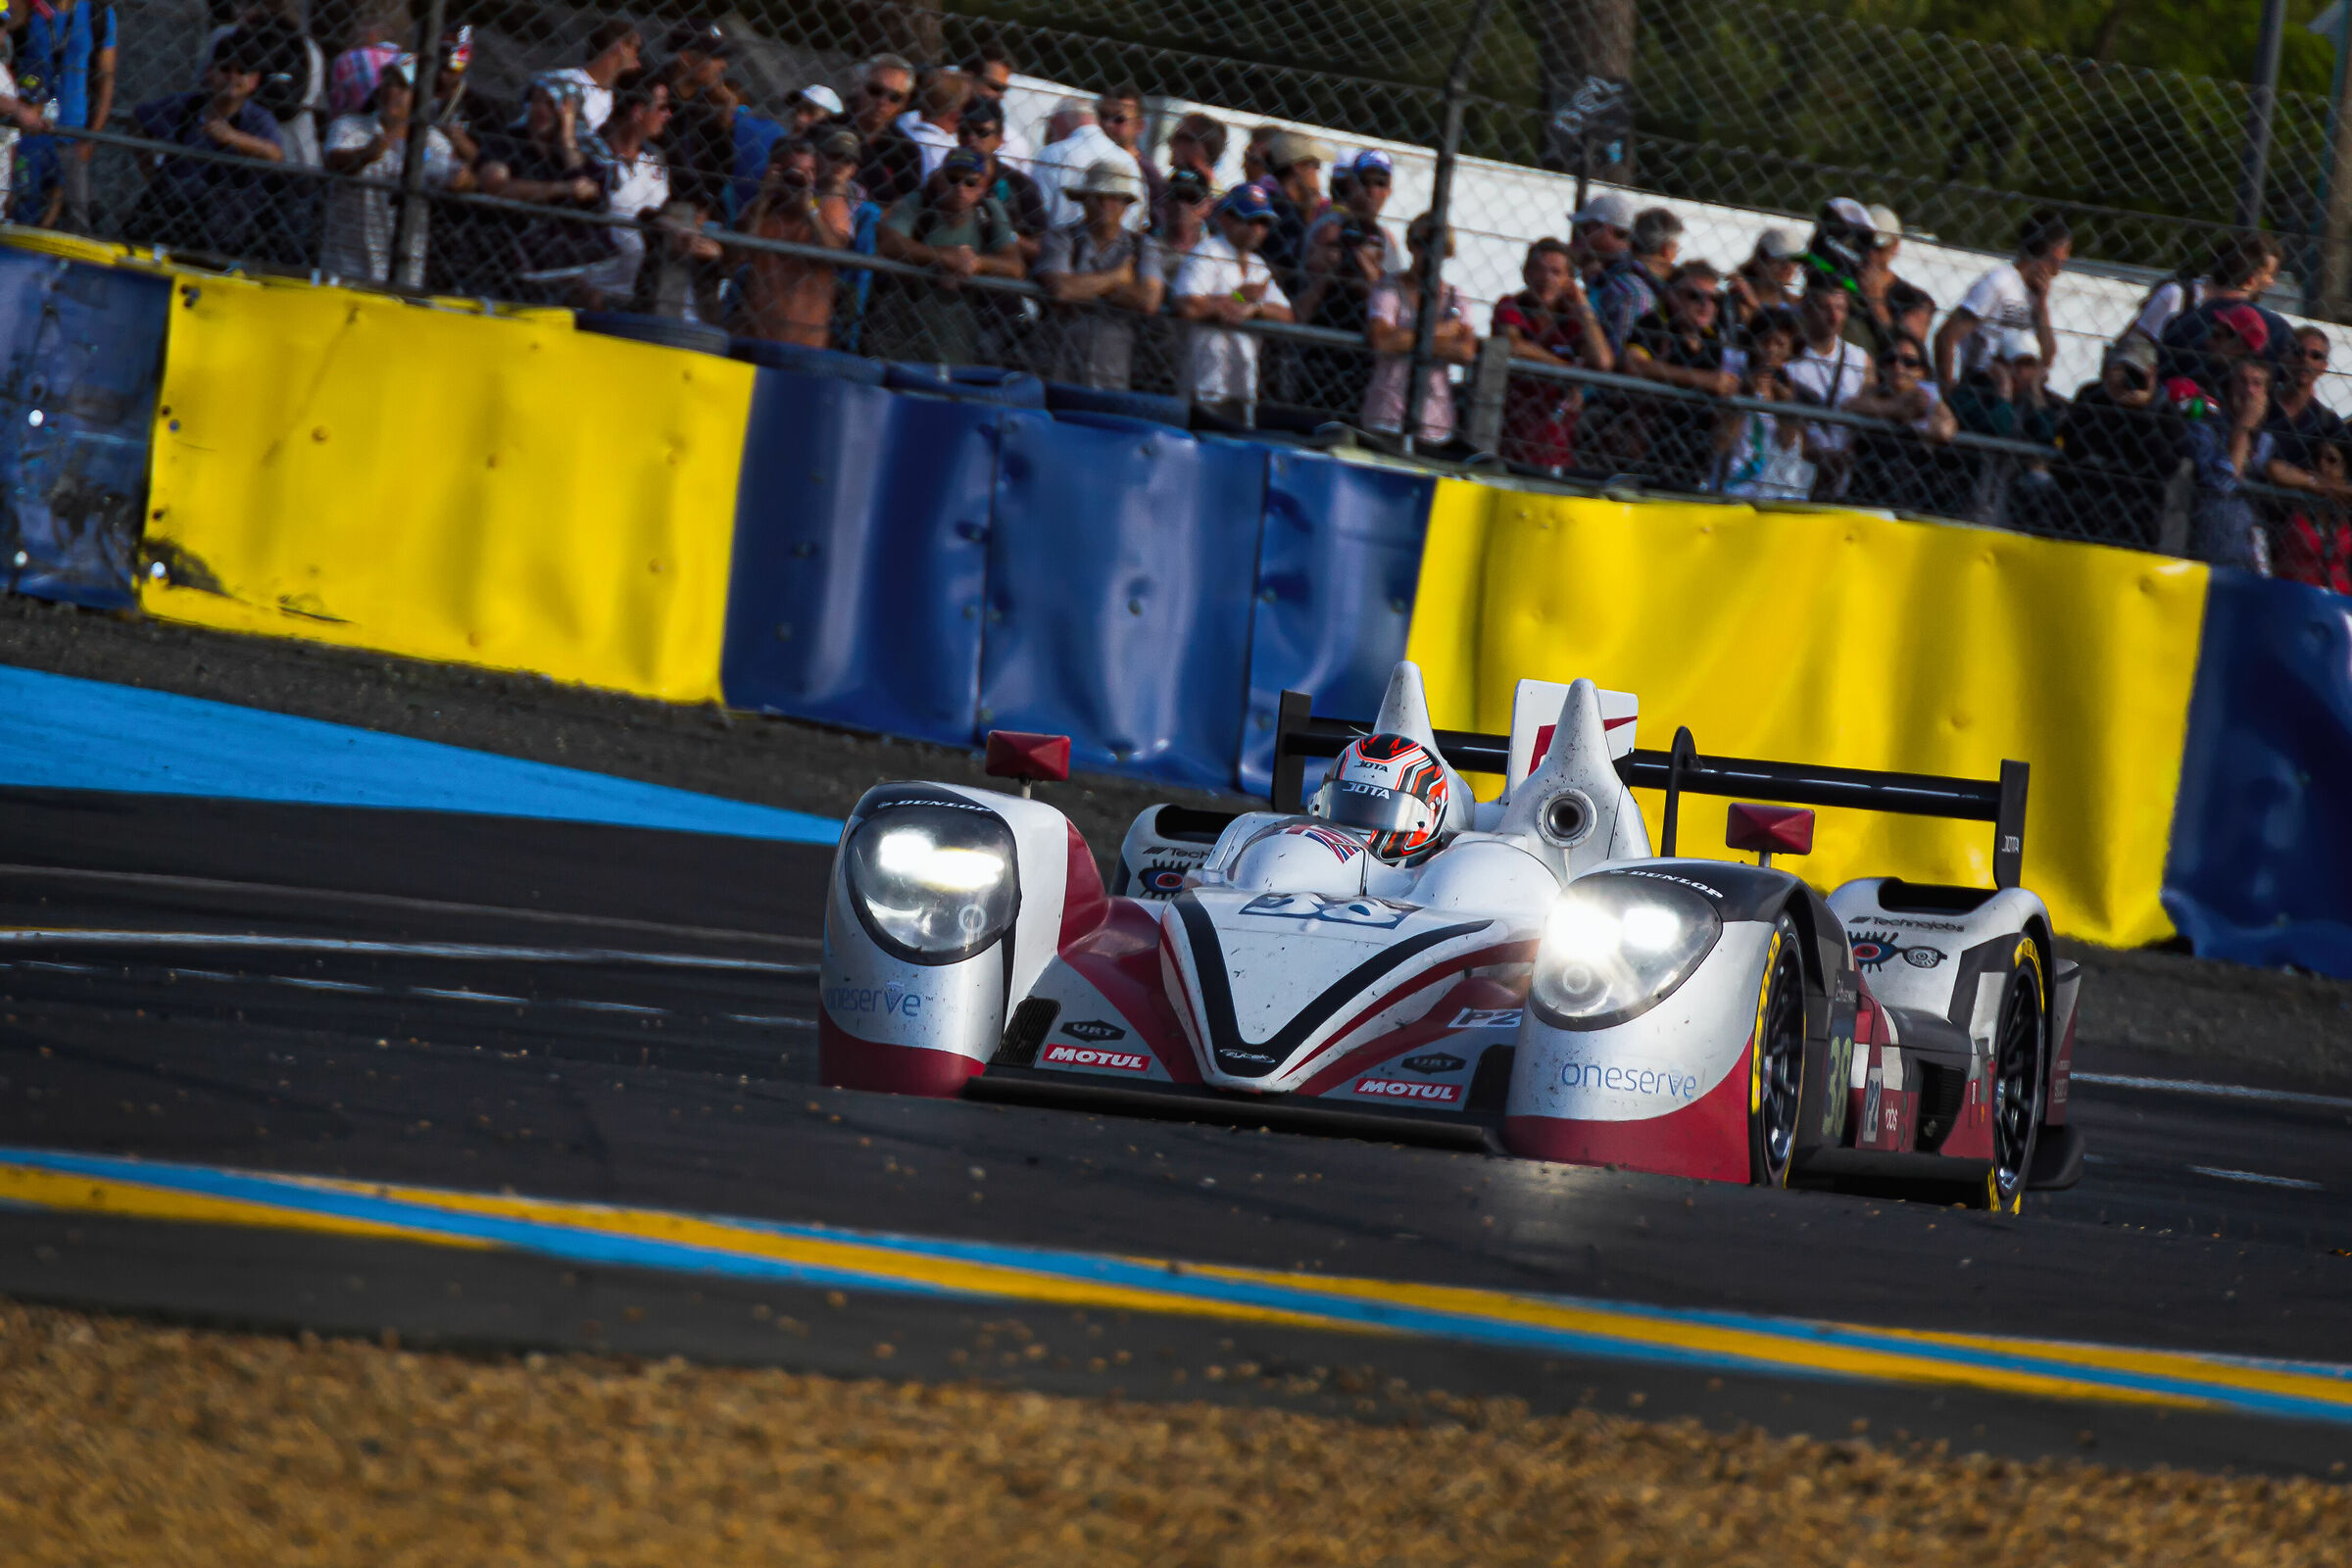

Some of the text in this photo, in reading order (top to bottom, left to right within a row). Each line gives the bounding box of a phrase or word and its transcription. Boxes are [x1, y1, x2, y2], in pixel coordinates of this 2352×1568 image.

[1354, 760, 1388, 773] JOTA
[1342, 783, 1390, 800] JOTA
[895, 800, 993, 812] DUNLOP
[1628, 870, 1724, 899] DUNLOP
[1457, 1010, 1523, 1025] P2
[1048, 1047, 1143, 1068] MOTUL
[1358, 1080, 1454, 1100] MOTUL
[1561, 1062, 1697, 1099] oneserve
[1821, 1035, 1853, 1137] 38
